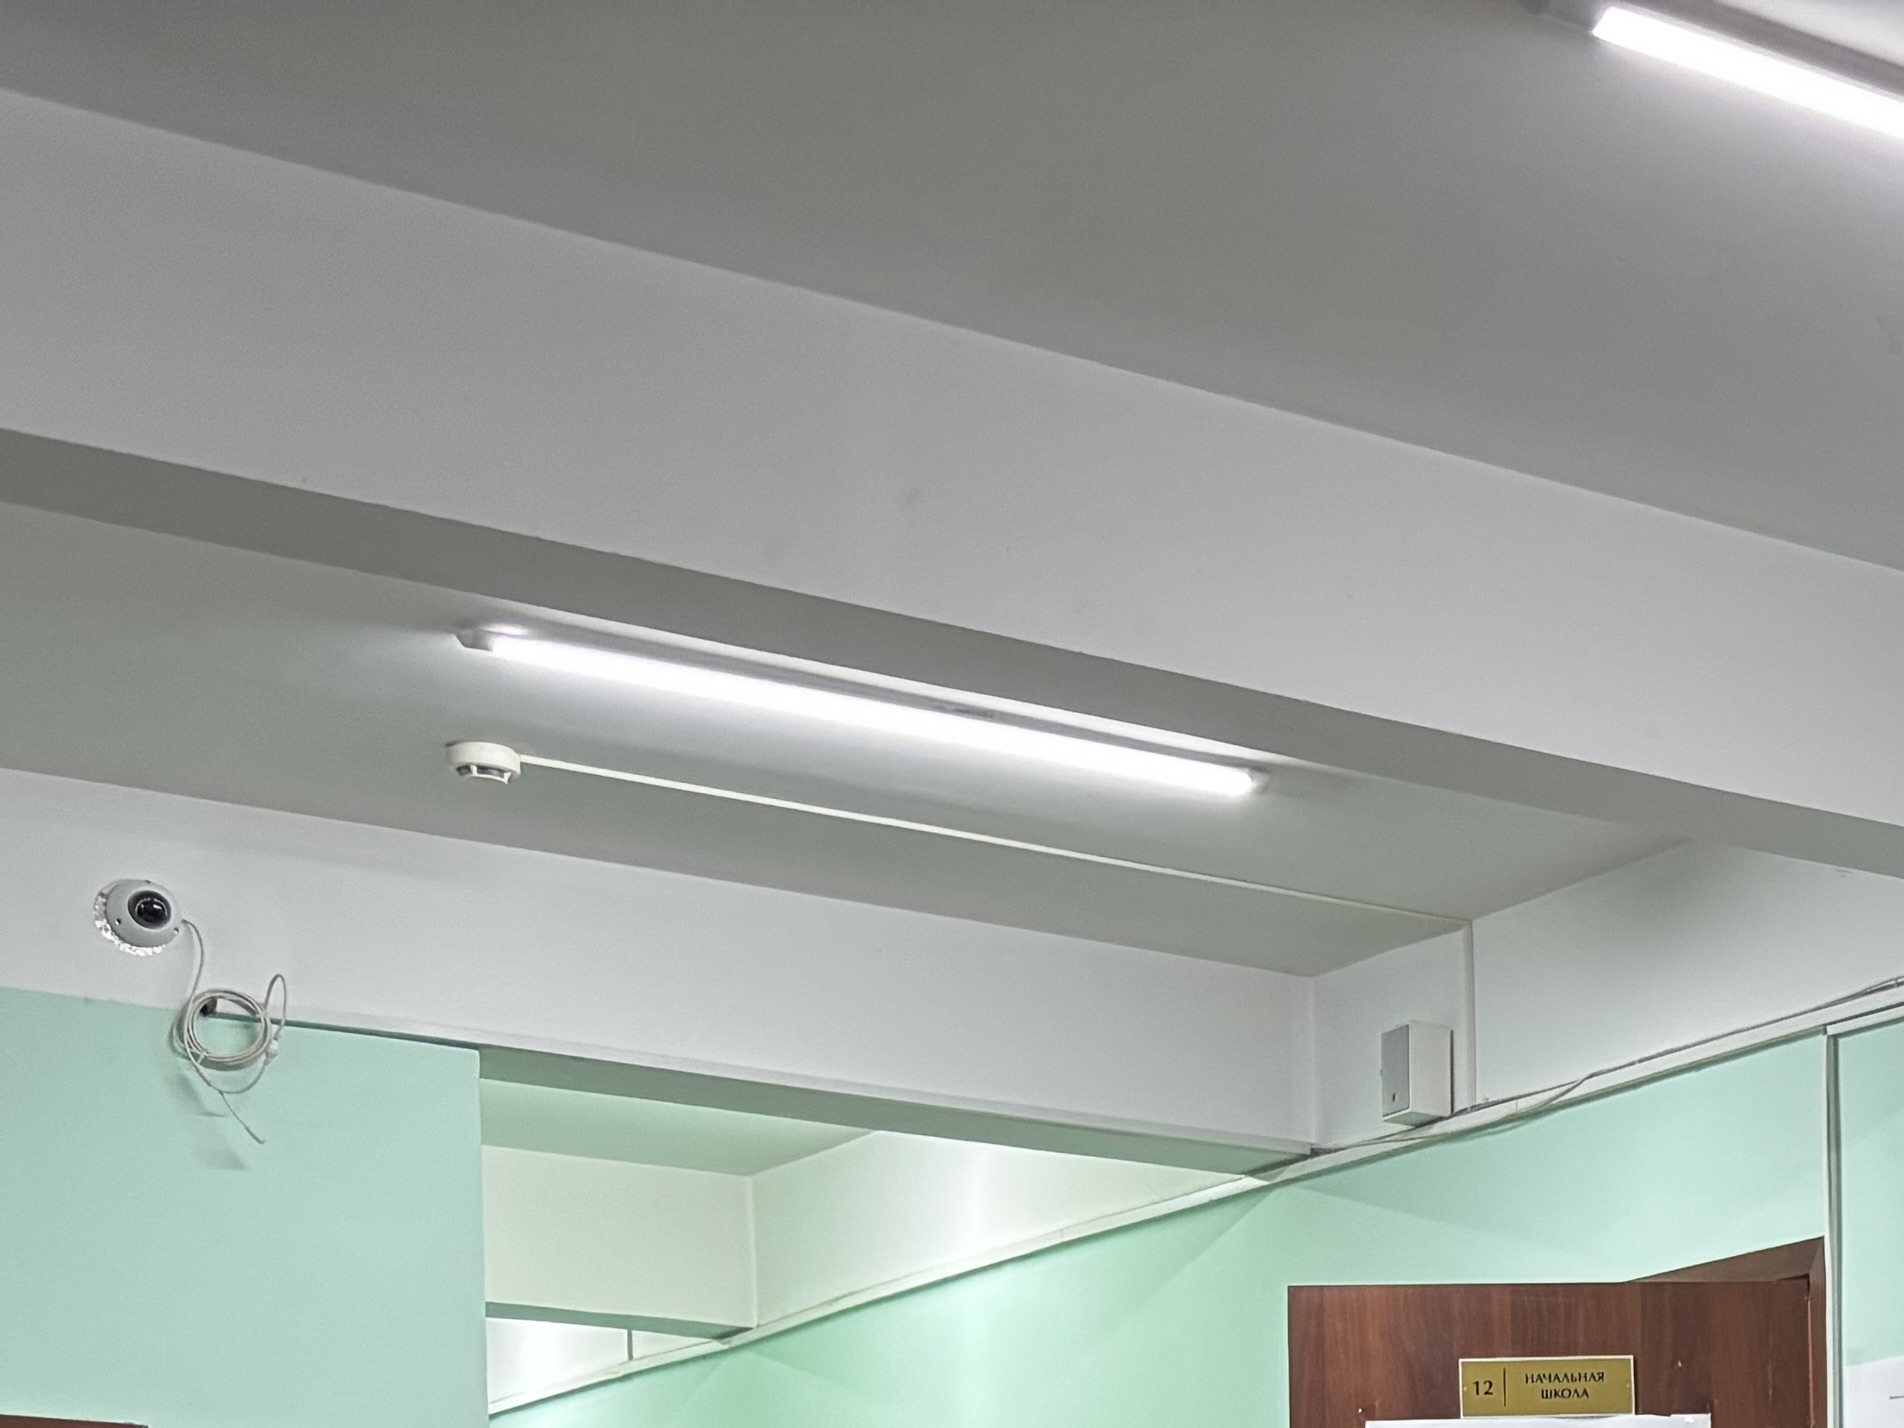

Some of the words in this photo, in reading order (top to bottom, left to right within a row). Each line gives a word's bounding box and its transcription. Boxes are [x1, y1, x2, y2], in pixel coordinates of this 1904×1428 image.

[1525, 1371, 1605, 1384] НАЧАЛЬНАЯ
[1473, 1380, 1493, 1396] 12
[1541, 1388, 1589, 1399] ШКОЛА
